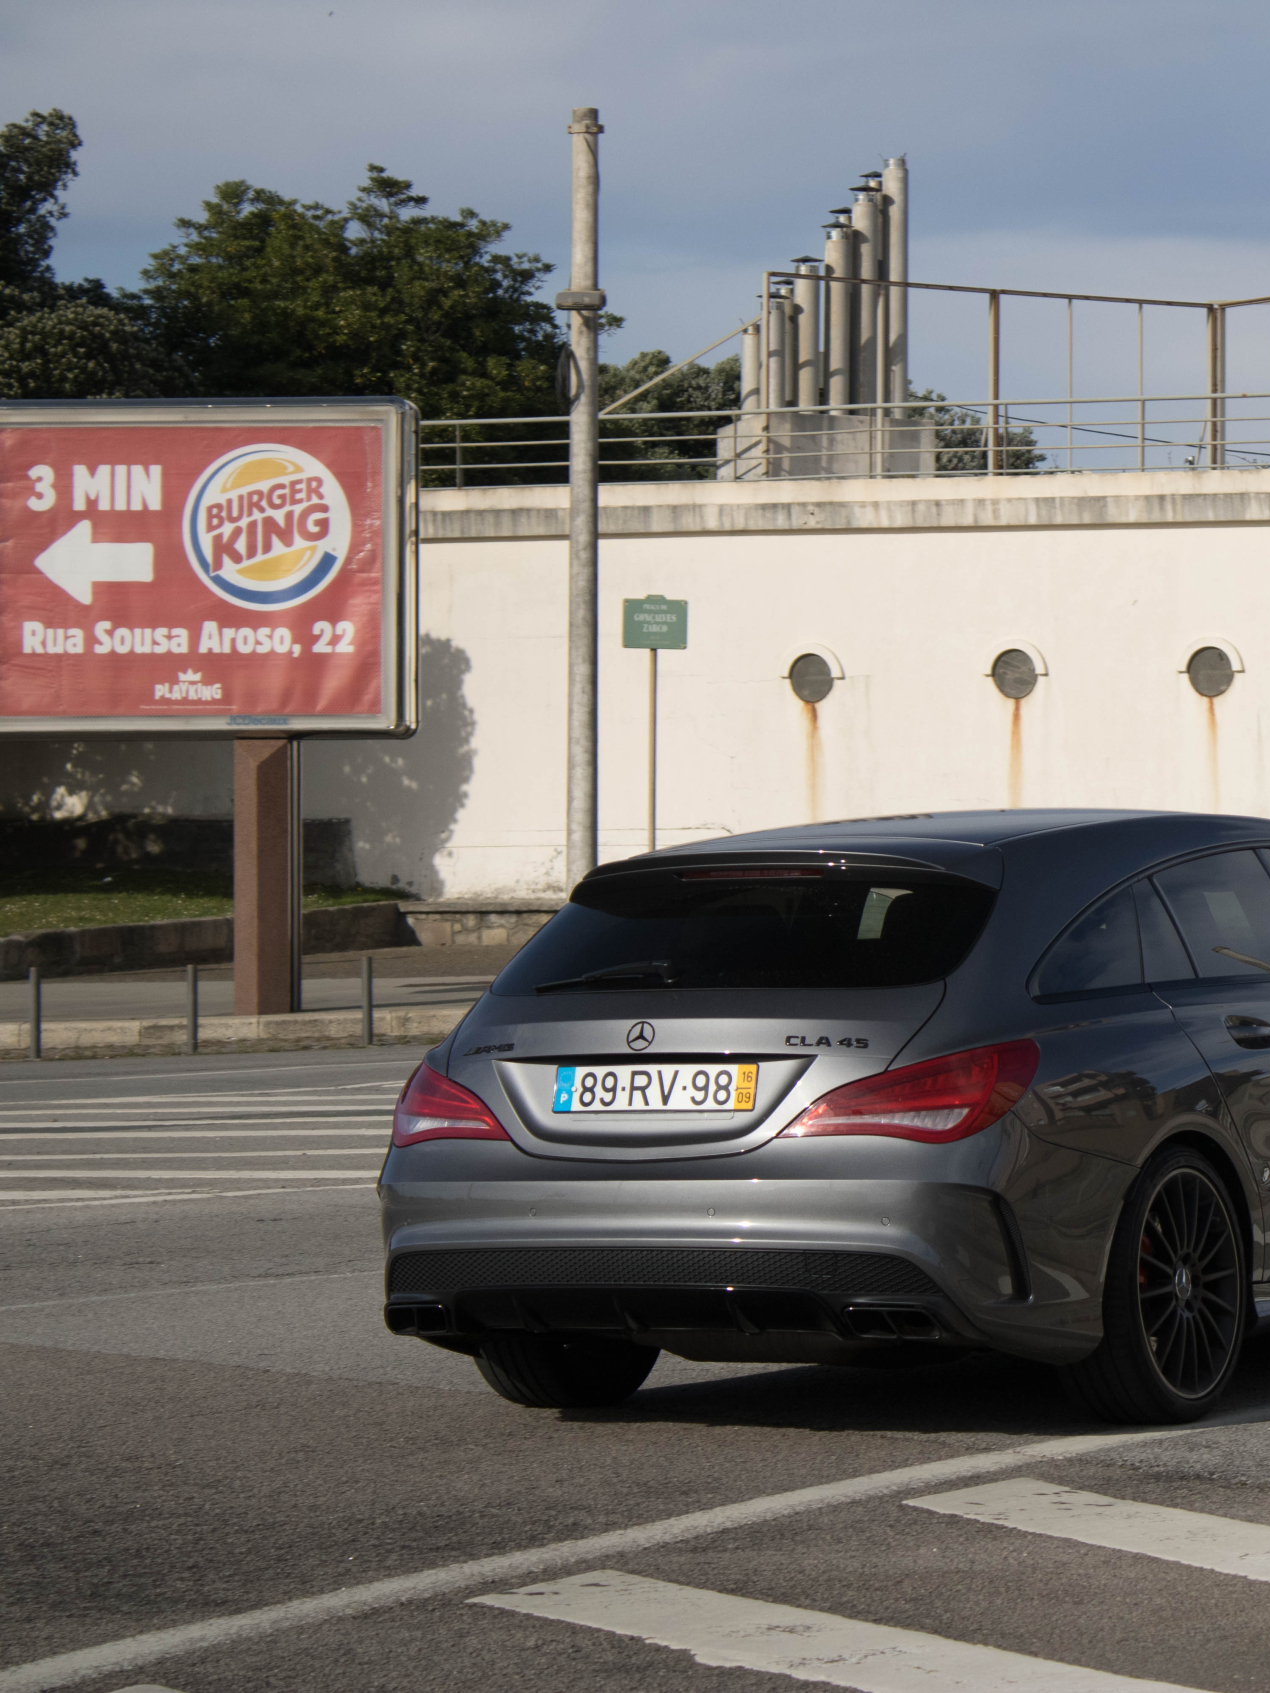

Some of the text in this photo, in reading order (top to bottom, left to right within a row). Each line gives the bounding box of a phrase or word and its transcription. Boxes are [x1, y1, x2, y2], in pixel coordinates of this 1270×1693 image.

[26, 465, 162, 512] 3 MIN
[205, 476, 325, 534] BURGER
[209, 503, 330, 576] KING
[22, 621, 355, 657] Rua Sousa Aroso, 22
[154, 682, 222, 701] PLAYKING
[225, 715, 288, 726] JCDecaux
[785, 1035, 870, 1049] CLA 45
[742, 1071, 753, 1083] 16
[560, 1093, 568, 1104] P
[737, 1091, 751, 1104] 09
